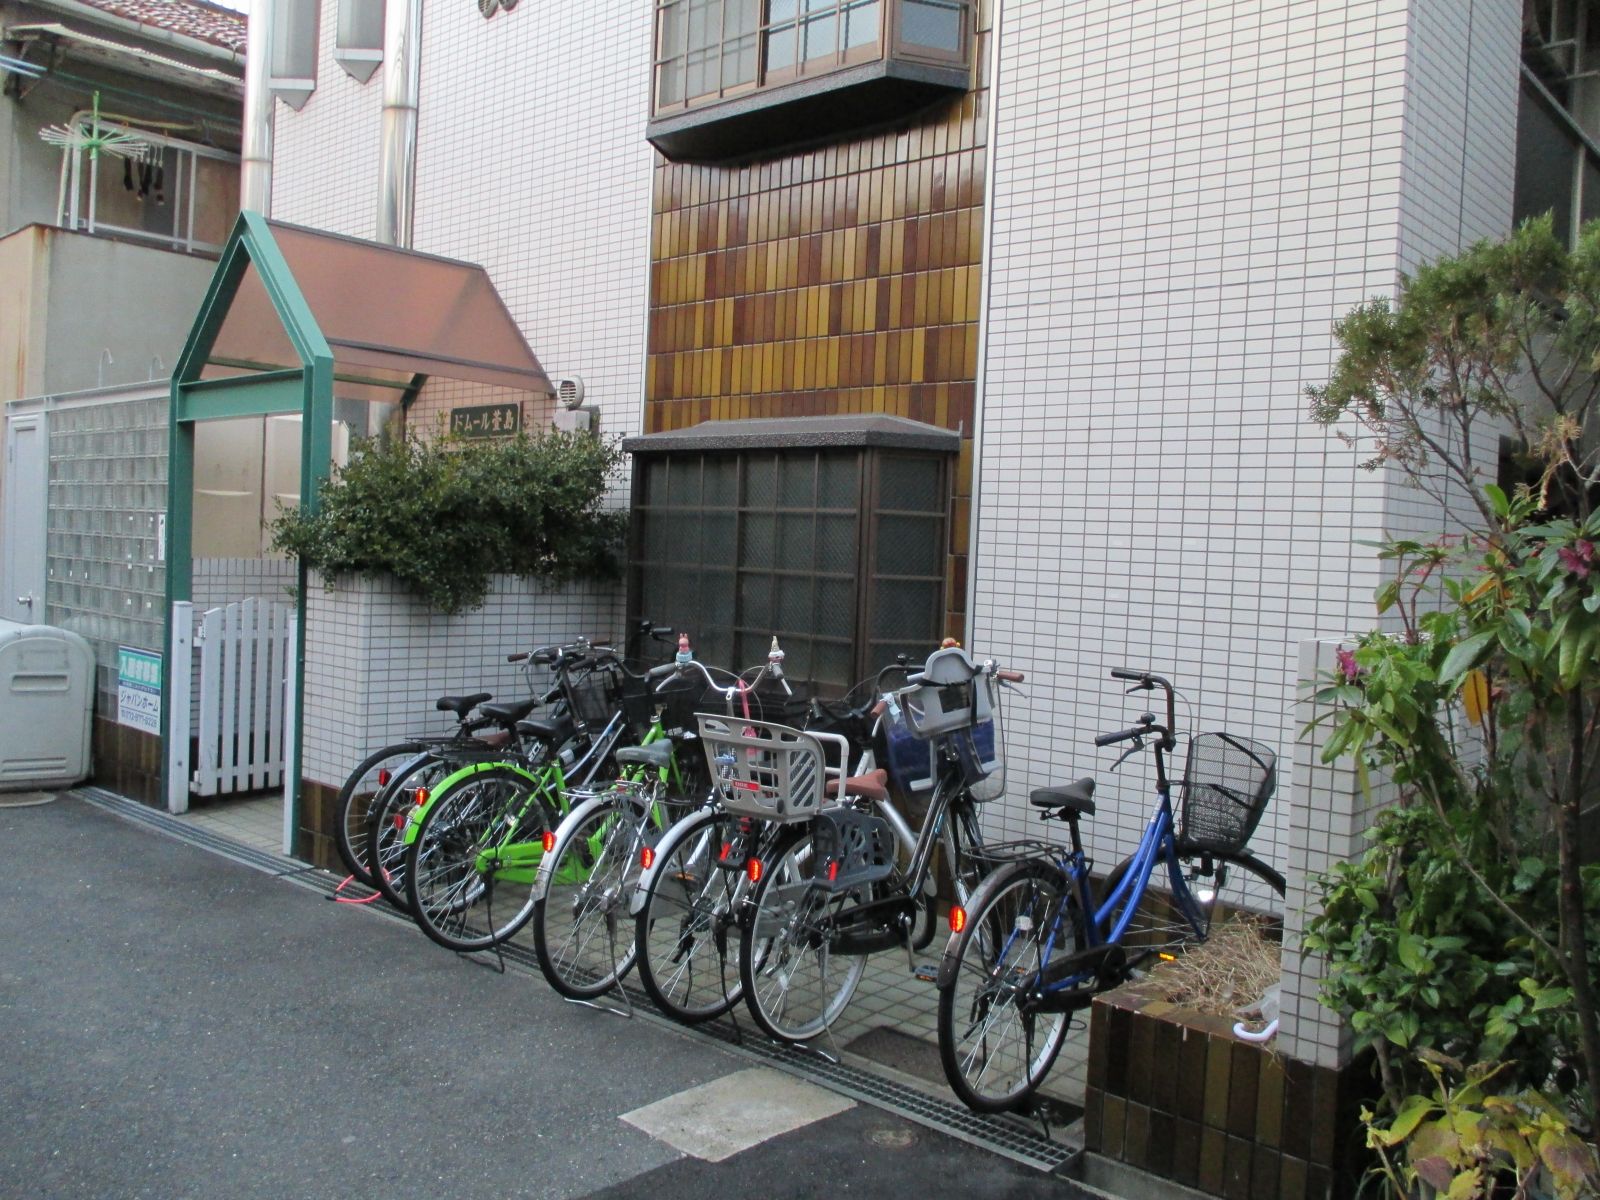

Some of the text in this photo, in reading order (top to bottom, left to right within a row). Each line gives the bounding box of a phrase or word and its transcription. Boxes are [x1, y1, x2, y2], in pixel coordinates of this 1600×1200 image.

[120, 689, 159, 712] ジャパンホーム
